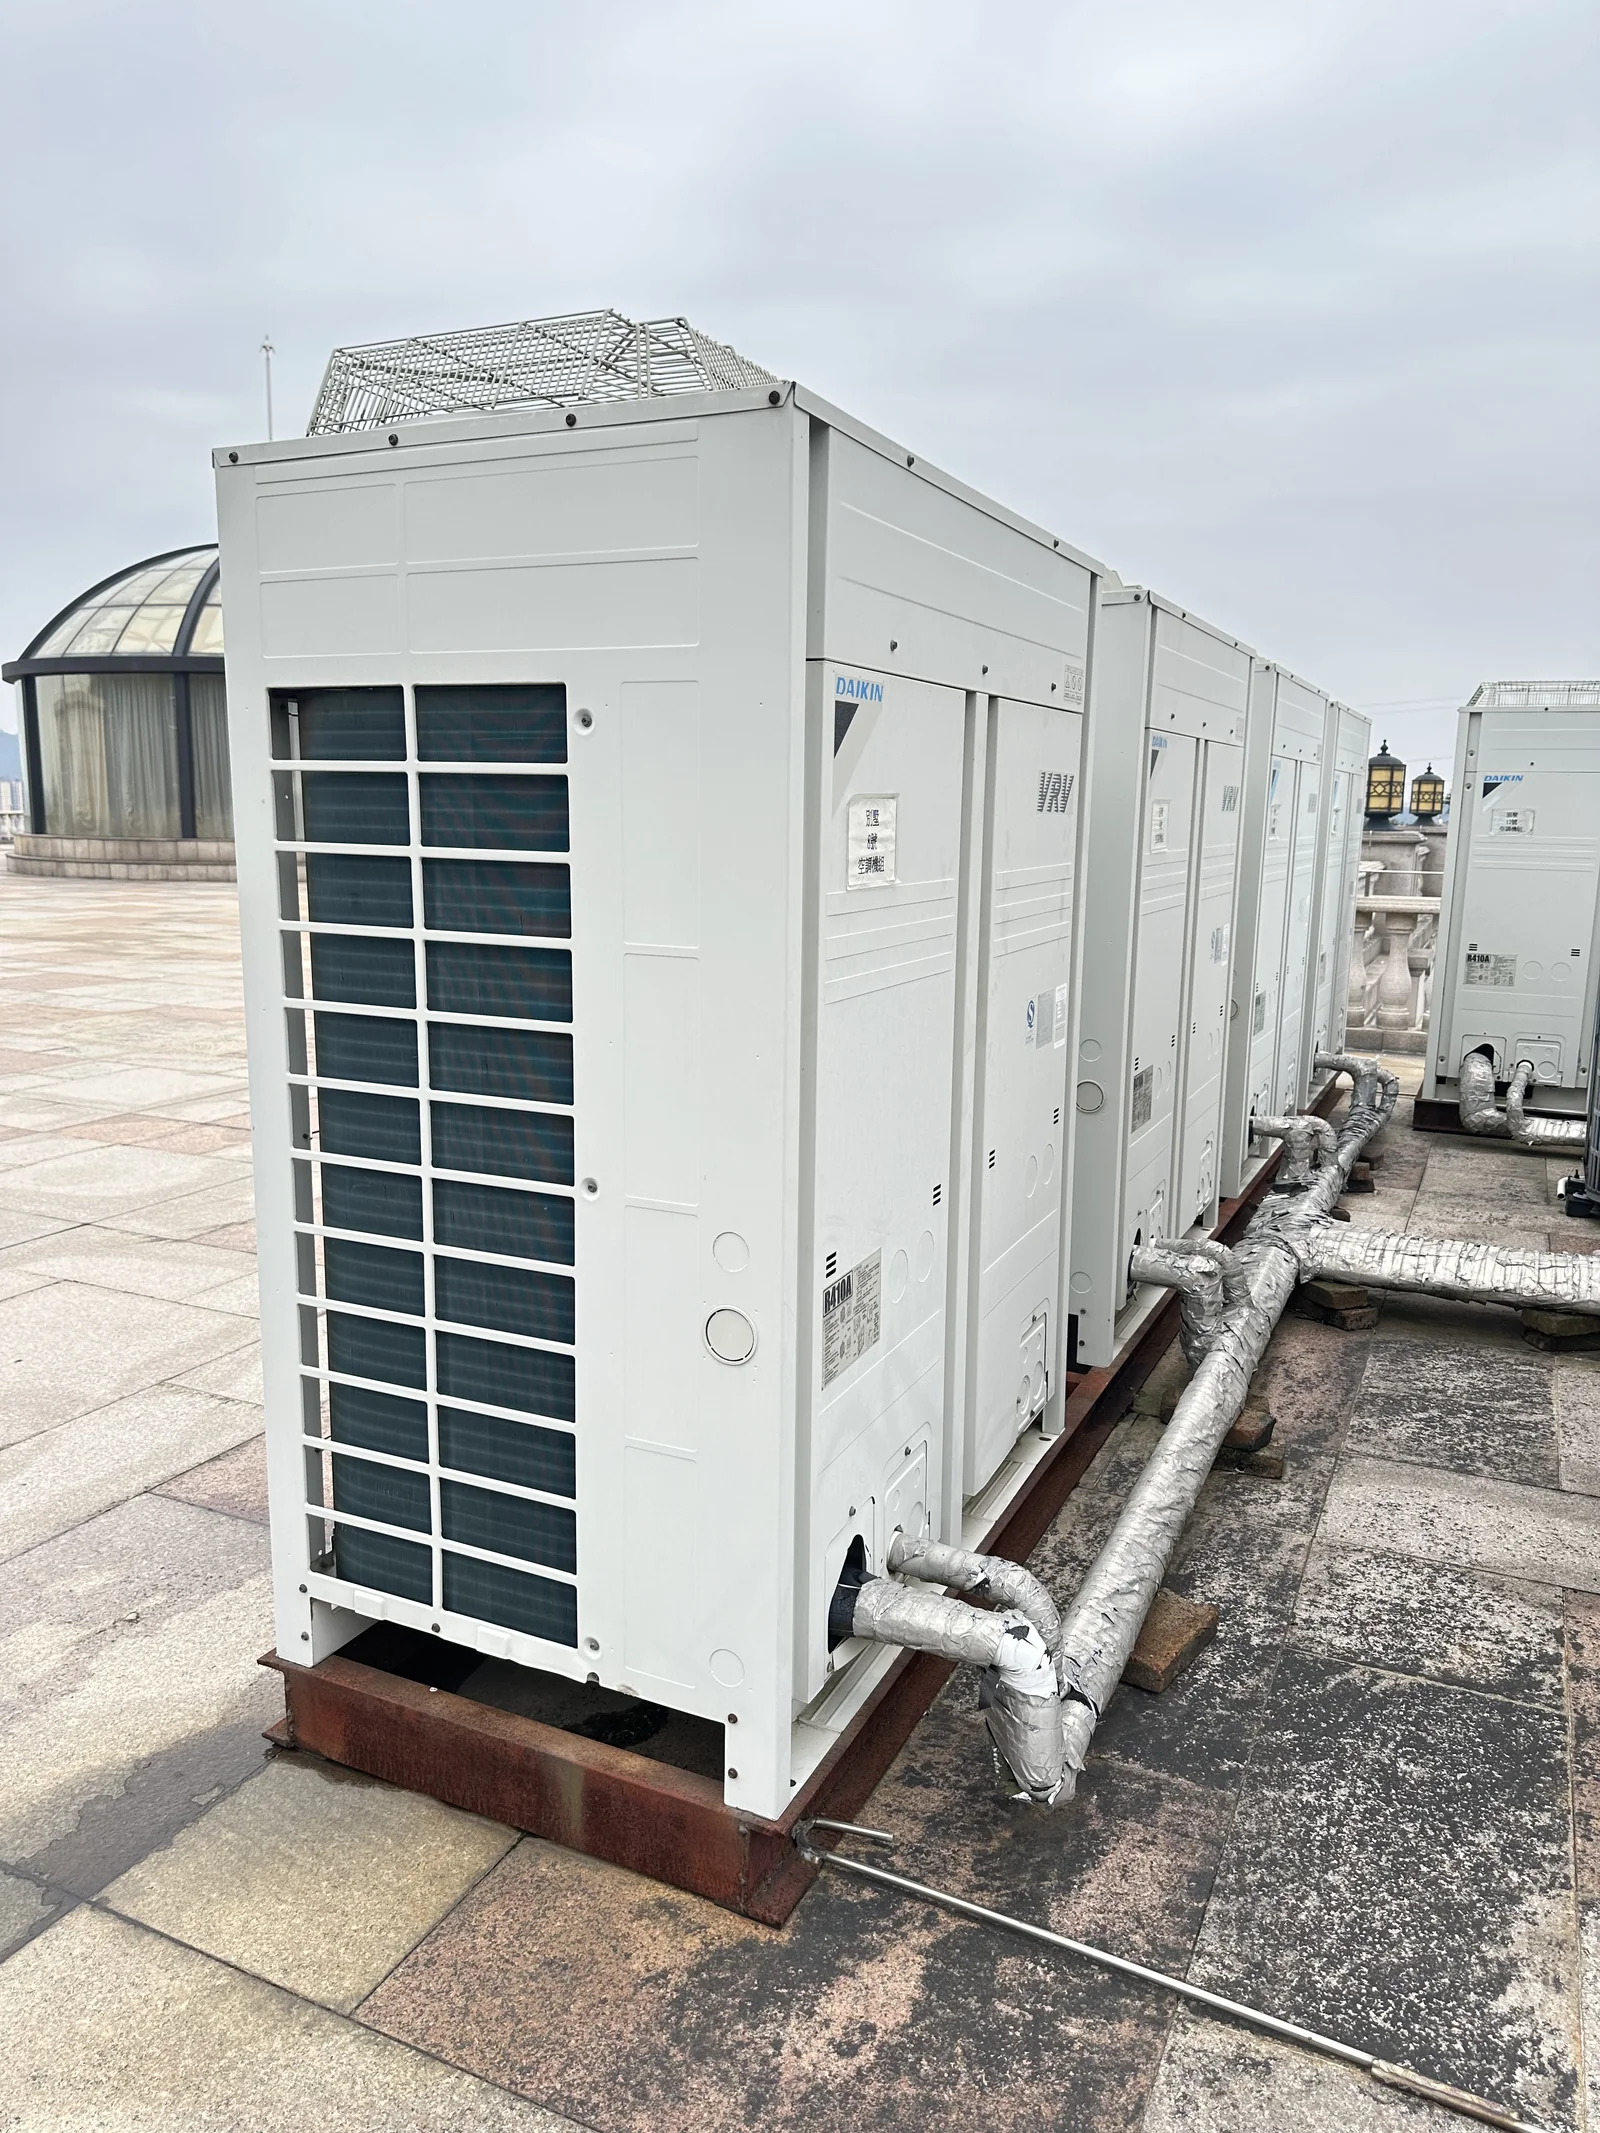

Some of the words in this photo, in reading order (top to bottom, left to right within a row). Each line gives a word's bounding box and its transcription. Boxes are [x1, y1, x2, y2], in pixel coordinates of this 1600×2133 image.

[836, 677, 883, 702] DAIKIN
[1036, 771, 1075, 813] VRV
[1467, 954, 1490, 963] R410A
[824, 1274, 852, 1315] R410A
